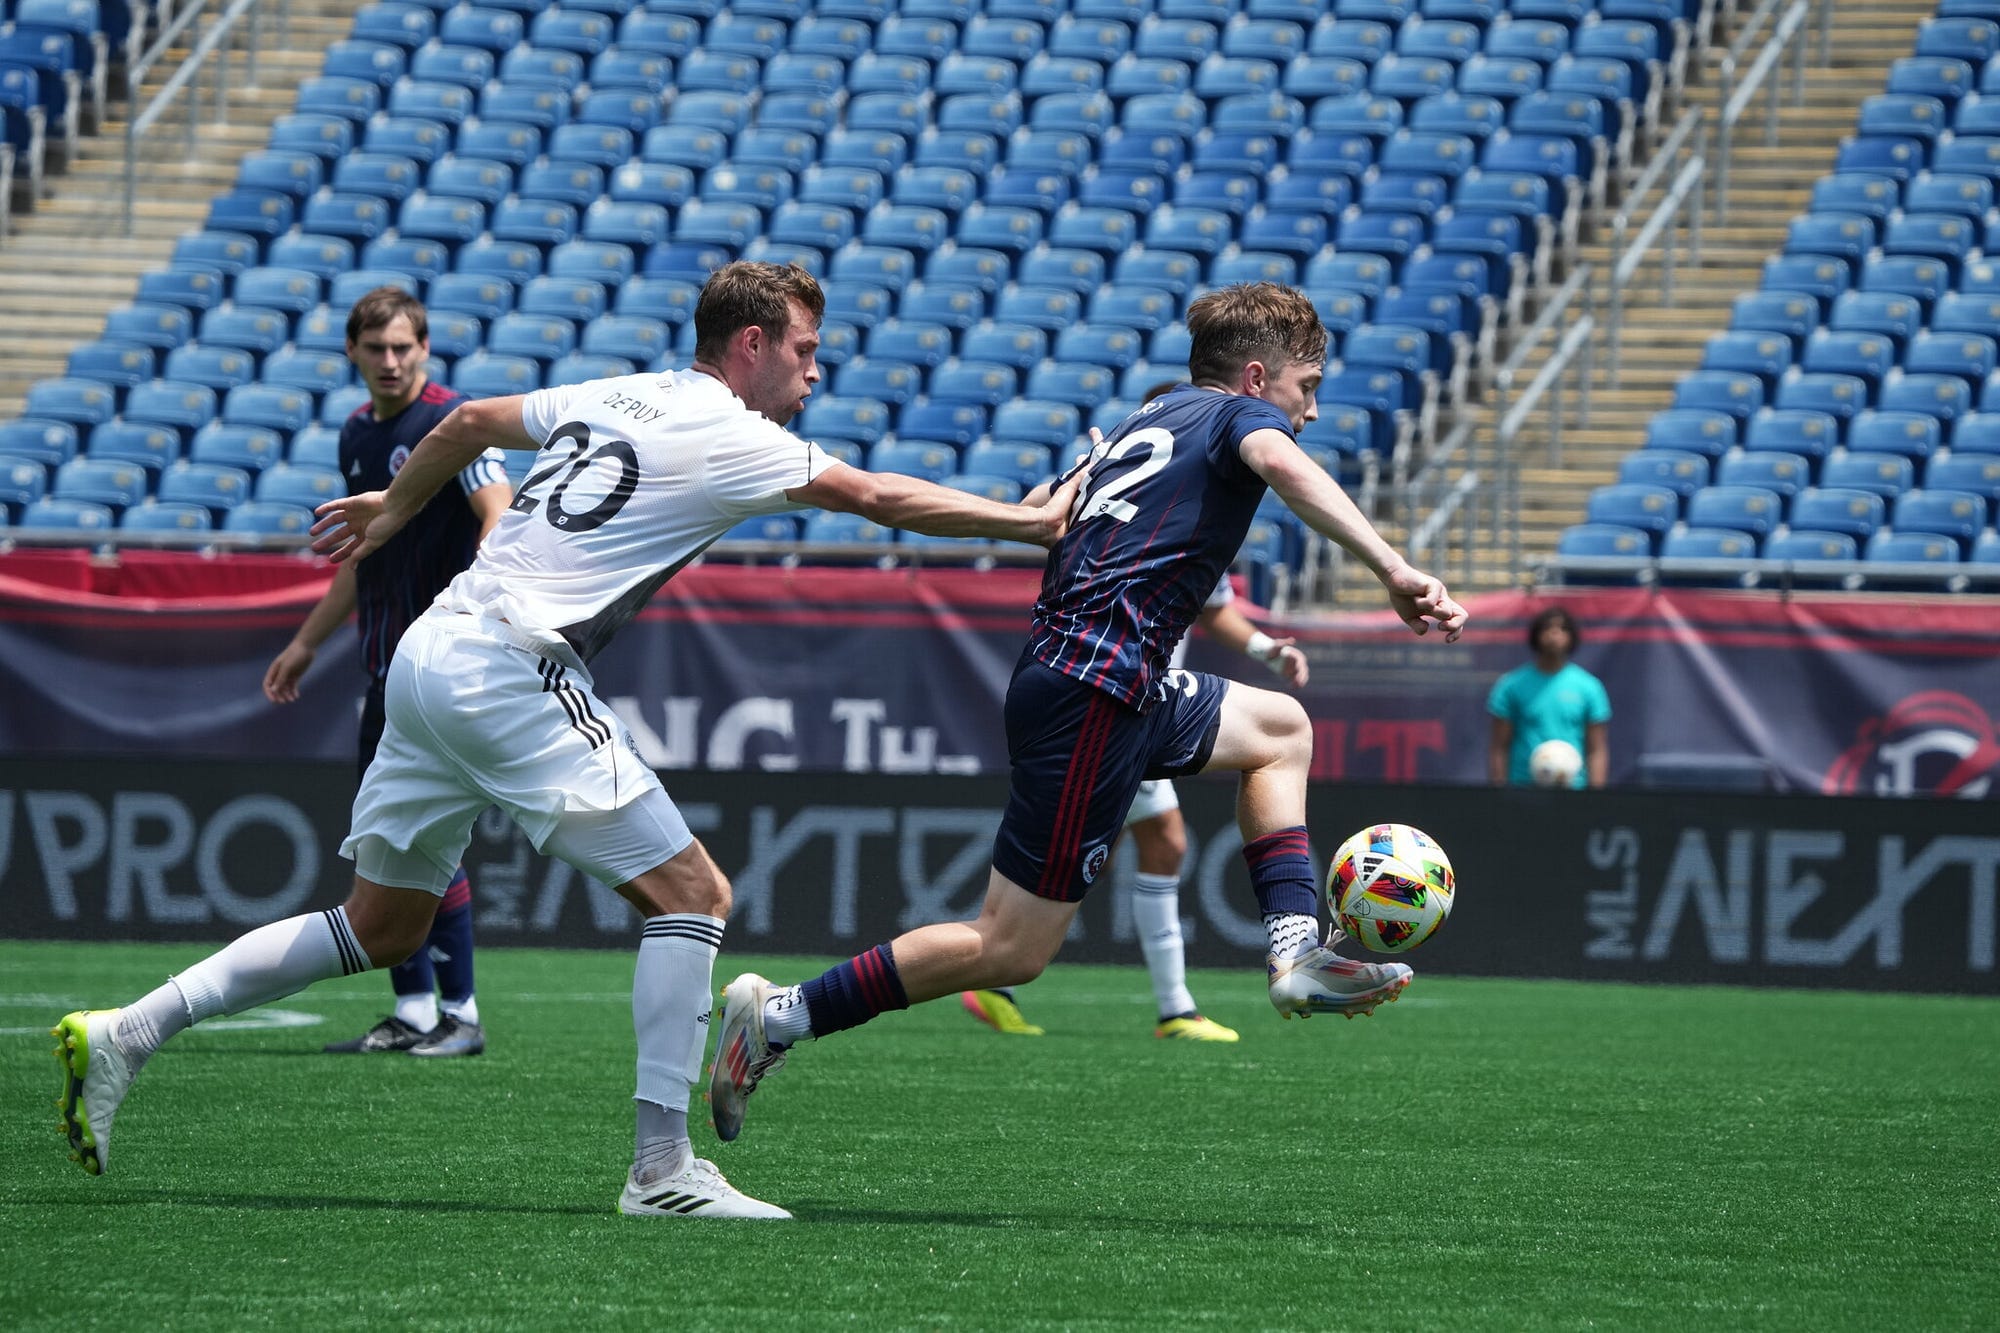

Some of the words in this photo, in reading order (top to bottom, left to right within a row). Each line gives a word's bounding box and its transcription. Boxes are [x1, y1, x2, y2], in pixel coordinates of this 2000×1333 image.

[602, 391, 667, 424] DEPUY
[510, 420, 640, 532] 20
[23, 789, 320, 924] PRO
[1584, 826, 1640, 961] MLS
[1641, 828, 2000, 971] NEXT
